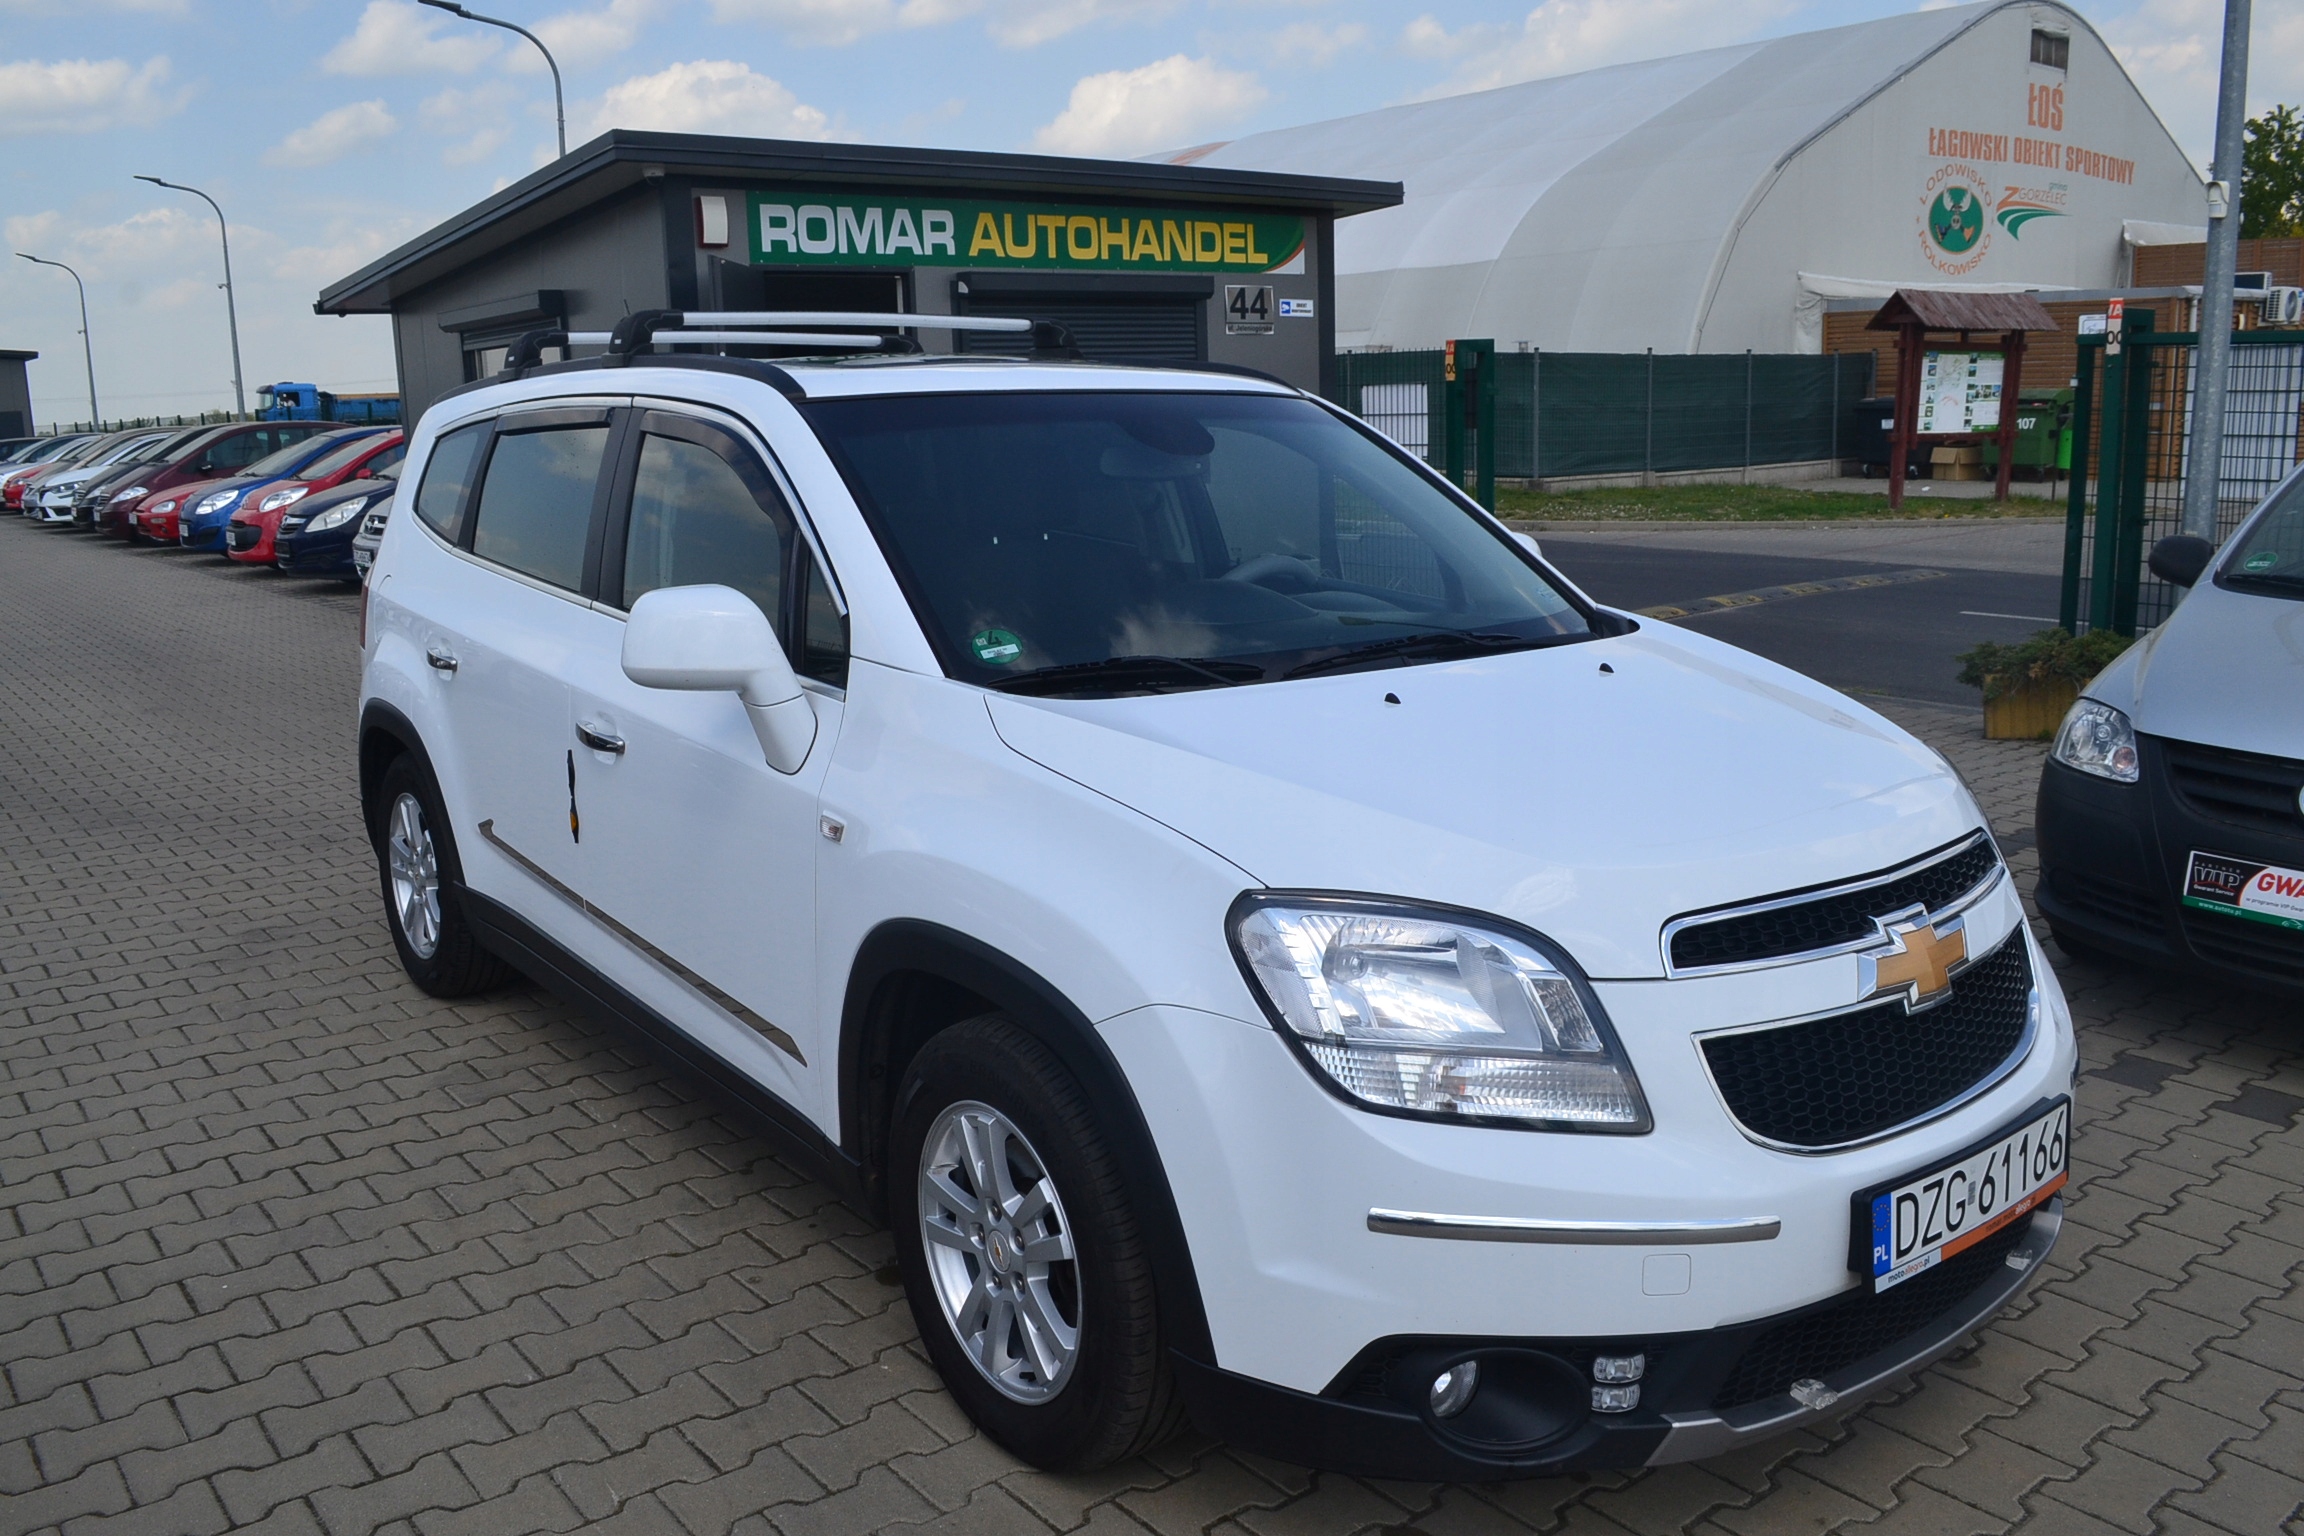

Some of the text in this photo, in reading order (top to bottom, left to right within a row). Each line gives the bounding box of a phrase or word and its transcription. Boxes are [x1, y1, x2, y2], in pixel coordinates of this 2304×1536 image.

[2028, 83, 2064, 131] ŁOŚ
[1929, 127, 2135, 185] ŁAGOWSKI OBIEKT SPORTOWY
[759, 204, 1269, 264] ROMAR AUTOHANDEL
[1918, 230, 1991, 275] ROLKOWISKO
[1230, 287, 1268, 320] 44
[2016, 418, 2036, 430] 107
[2194, 866, 2240, 888] VIP
[2215, 888, 2234, 897] Service
[1895, 1109, 2064, 1261] DZG 61166
[1873, 1244, 1889, 1265] PL
[1887, 1255, 1931, 1284] motoallegro.pl
